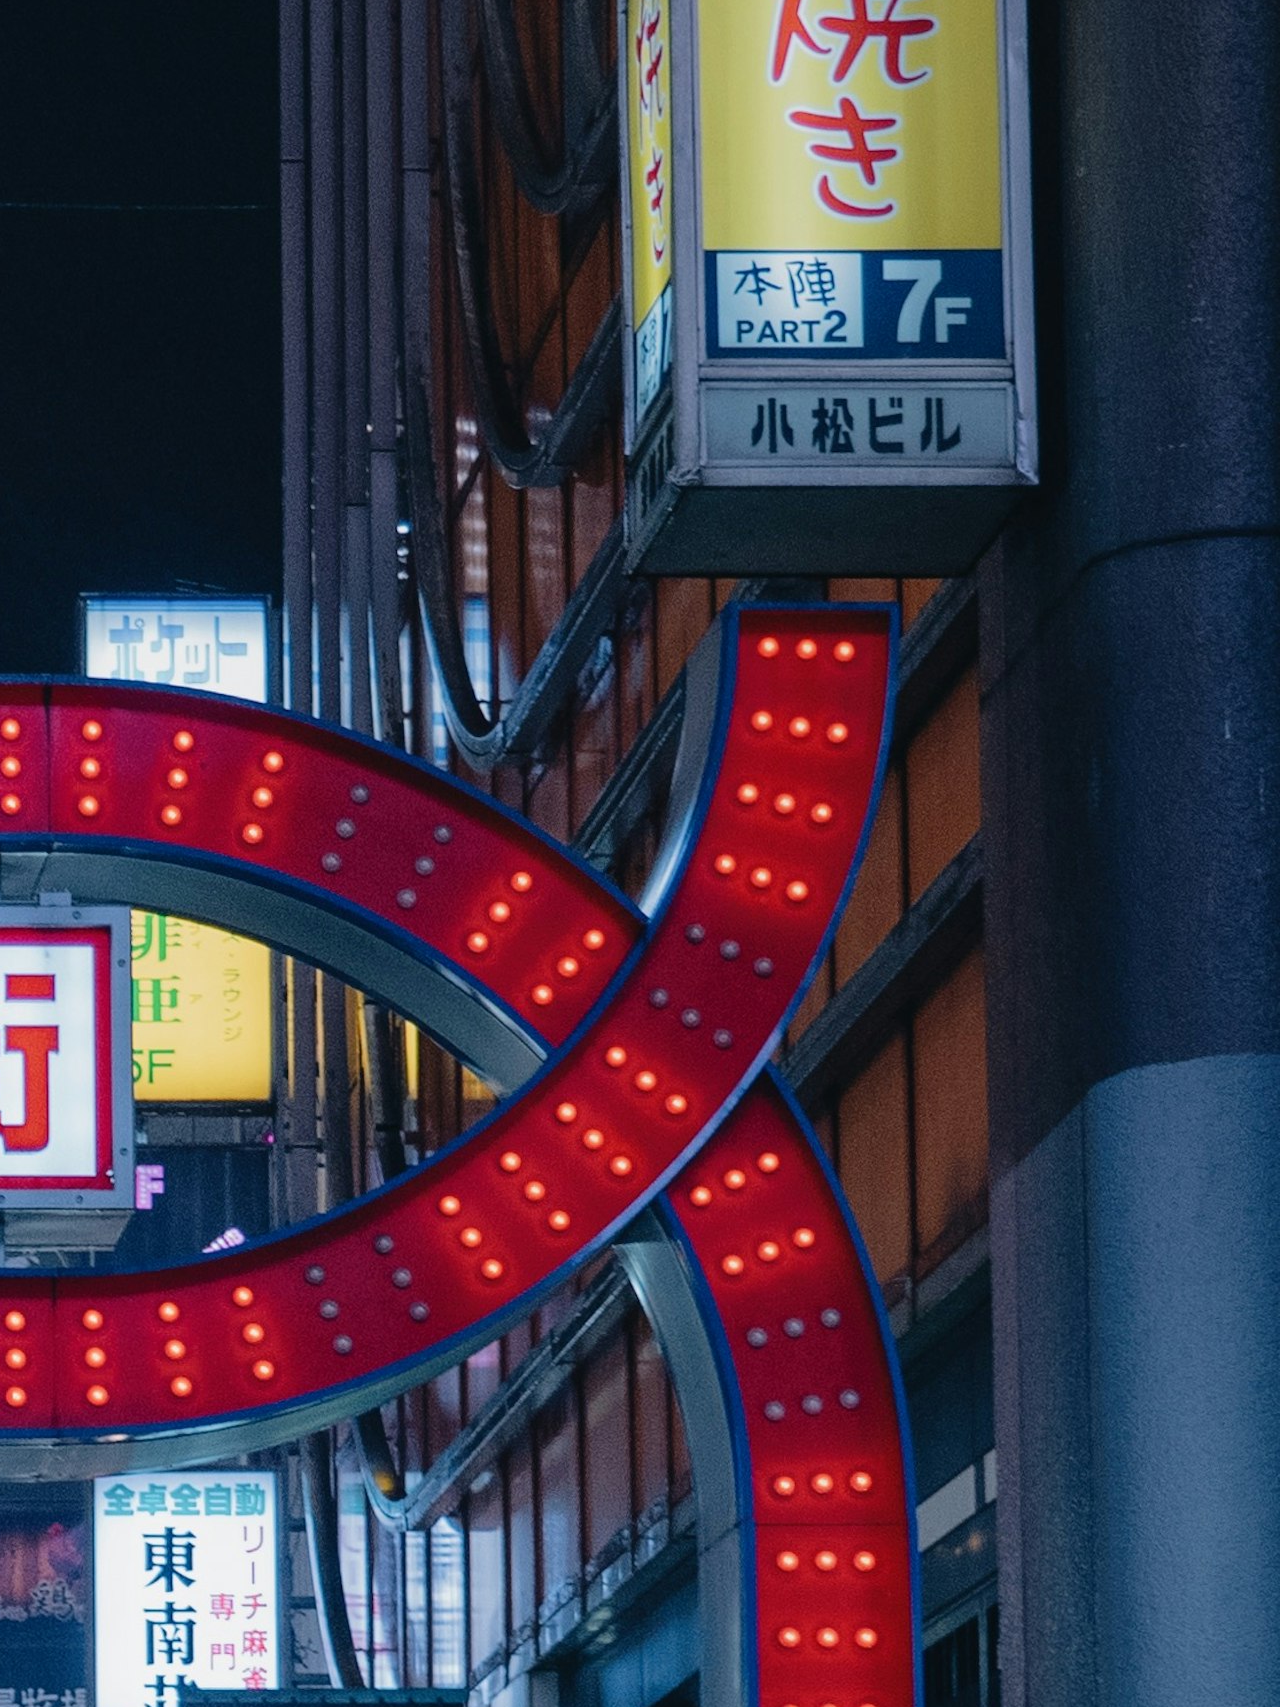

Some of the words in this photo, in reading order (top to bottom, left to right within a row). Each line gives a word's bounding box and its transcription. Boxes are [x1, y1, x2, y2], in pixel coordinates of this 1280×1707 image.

[733, 257, 837, 308] 本陣
[881, 259, 973, 343] 7F
[736, 310, 847, 344] PART2
[751, 398, 961, 454] 小松ビル
[102, 1483, 266, 1517] 全卓全自動
[210, 1593, 236, 1671] 専門
